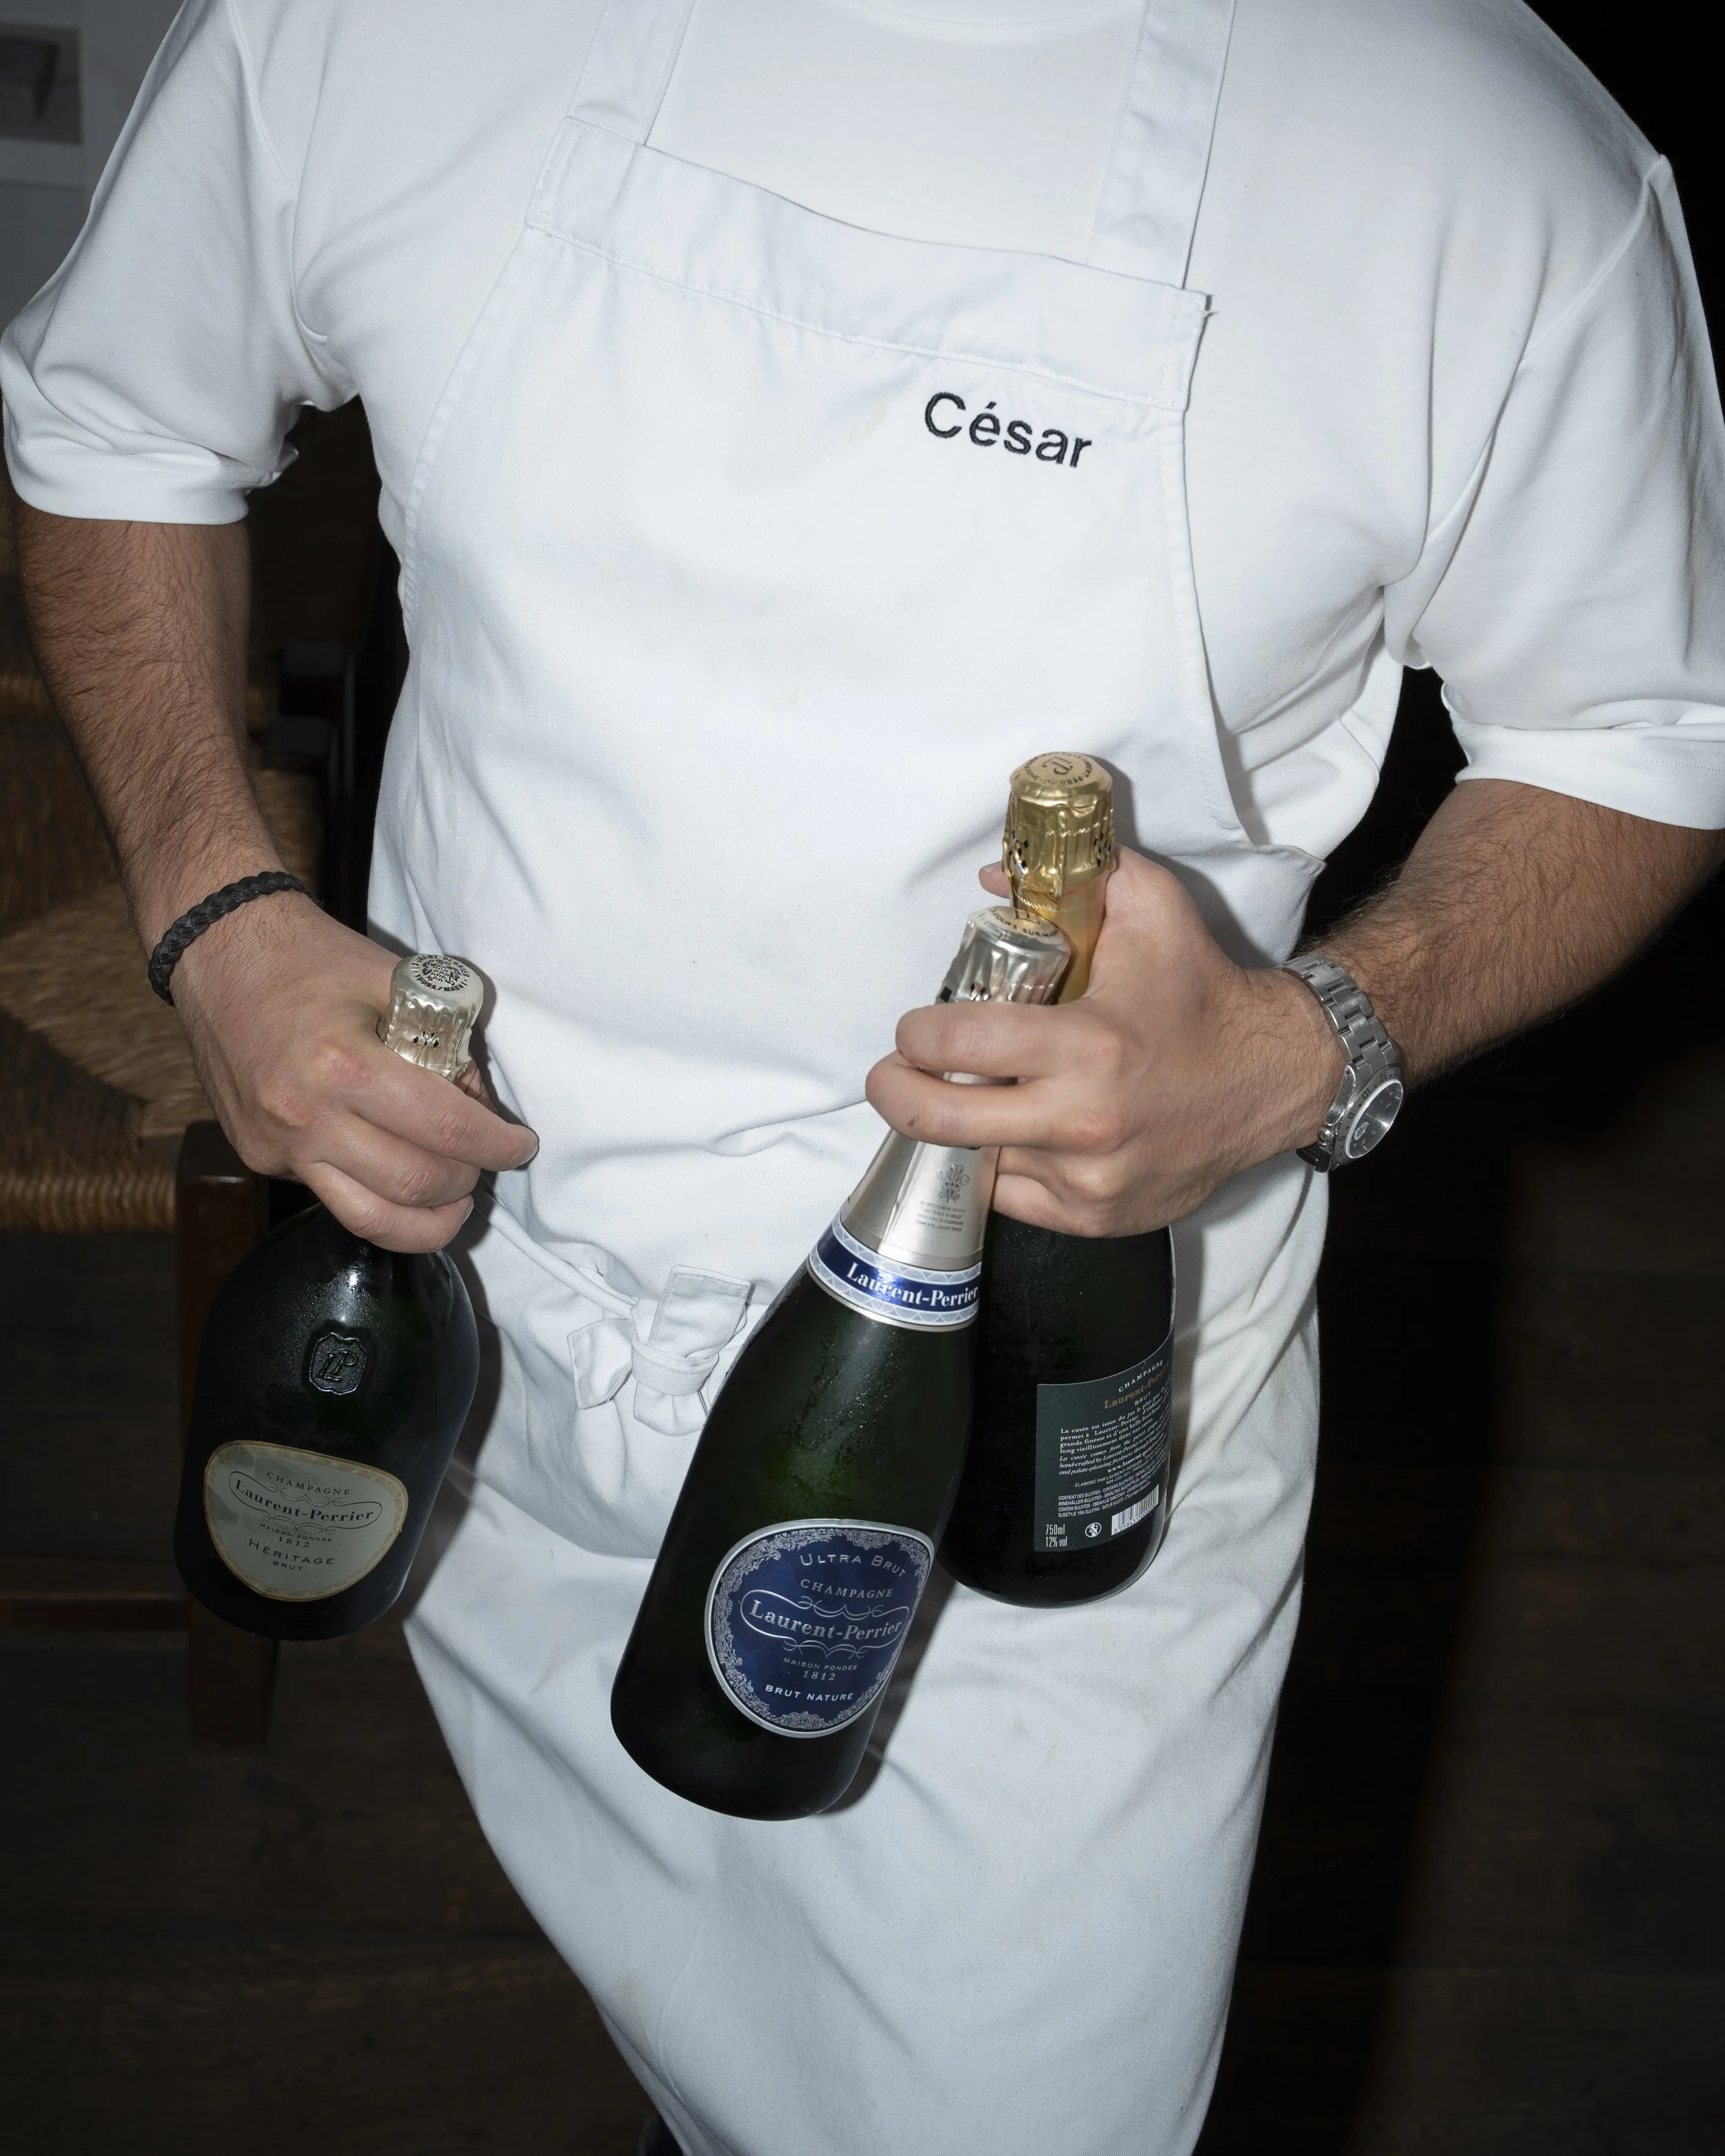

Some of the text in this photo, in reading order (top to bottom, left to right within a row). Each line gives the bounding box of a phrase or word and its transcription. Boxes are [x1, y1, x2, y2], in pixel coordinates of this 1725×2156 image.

[925, 391, 1092, 468] César
[846, 1261, 978, 1307] Laurent-Perrier
[1118, 1360, 1163, 1392] CHAMPAGNE
[1134, 1392, 1150, 1405] BRUT
[1126, 1411, 1135, 1419] jus
[1143, 1400, 1152, 1410] plus
[1060, 1440, 1083, 1449] grande
[1113, 1427, 1129, 1436] d'une
[1130, 1419, 1141, 1428] belle
[1094, 1415, 1139, 1435] Laurent-Perrier
[1076, 1438, 1117, 1452] vieillissement
[1059, 1458, 1095, 1467] hand-crafted
[1070, 1461, 1112, 1474] palate-pleasing
[266, 1471, 351, 1496] CHAMPAGNE
[1103, 1483, 1118, 1492] CONTAINS
[235, 1478, 373, 1522] Laurent-Perrier
[1084, 1494, 1102, 1503] SULFITER
[259, 1523, 333, 1543] MAISON FONDÉE
[1045, 1524, 1065, 1535] 750ml
[278, 1536, 310, 1548] 1812
[1045, 1536, 1067, 1547] 12% vol
[248, 1538, 335, 1565] HÉRITAGE
[273, 1560, 304, 1572] BRUT
[800, 1553, 906, 1578] ULTRA BRUT
[800, 1579, 894, 1599] CHAMPAGNE
[749, 1599, 903, 1641] Laurent-Perrier
[783, 1656, 820, 1670] MAISON
[802, 1670, 836, 1681] 1812
[765, 1684, 854, 1702] BRUT NATURE
